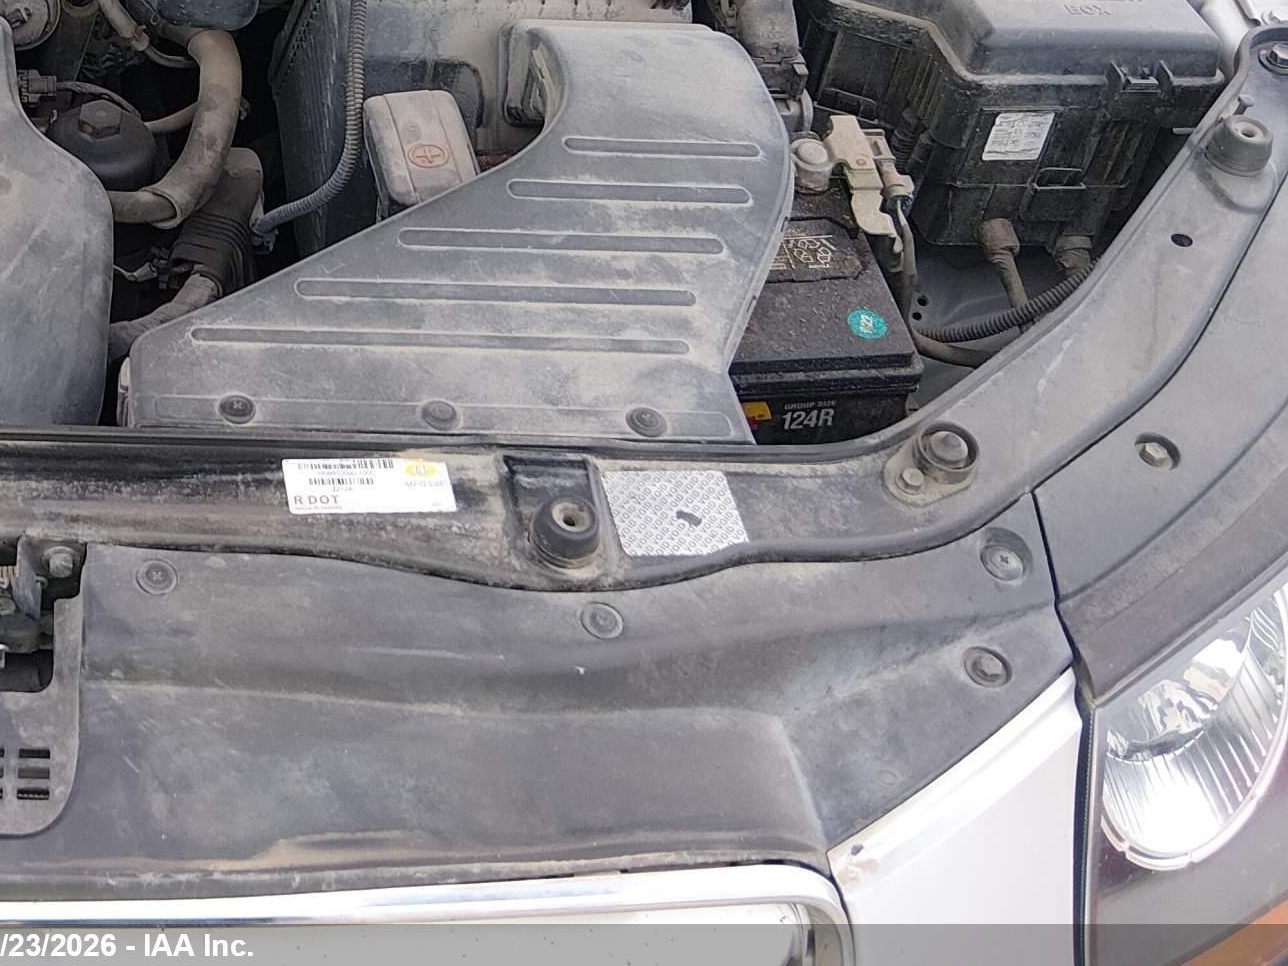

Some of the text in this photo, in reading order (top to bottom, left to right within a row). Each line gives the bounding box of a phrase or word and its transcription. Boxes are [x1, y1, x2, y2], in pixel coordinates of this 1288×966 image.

[1063, 3, 1112, 16] BOX
[782, 408, 835, 430] 124R
[308, 494, 339, 505] DOT
